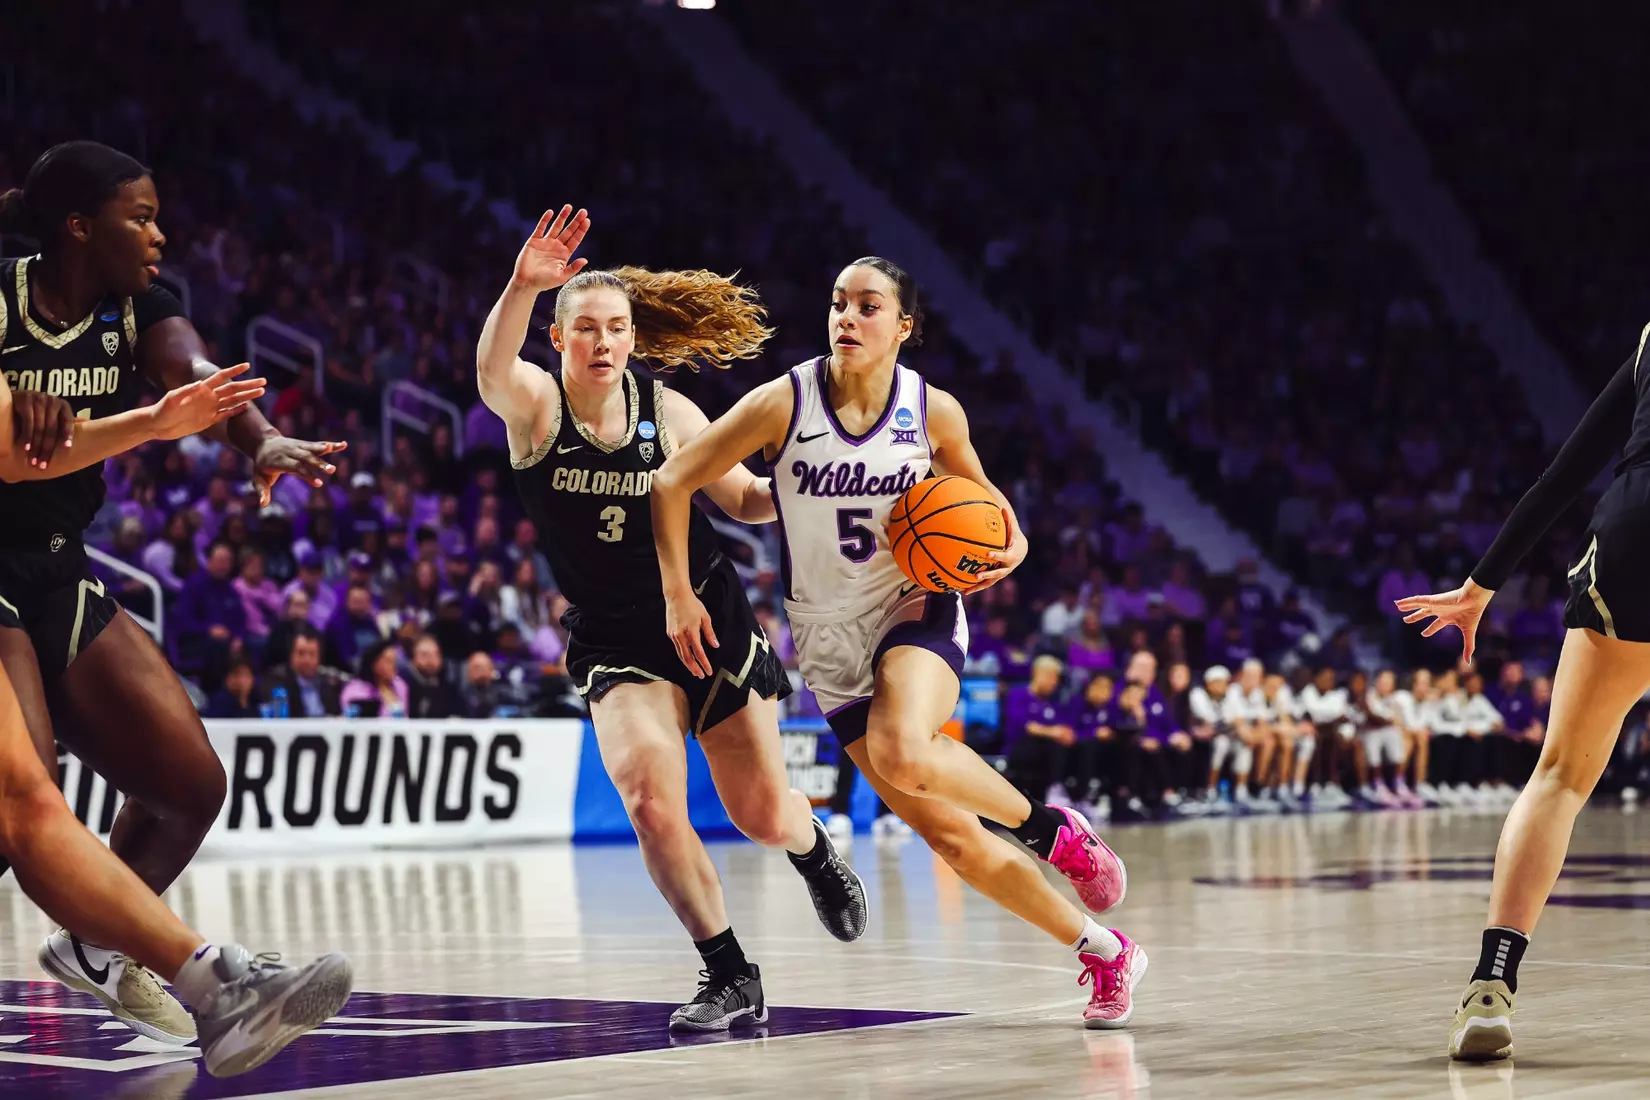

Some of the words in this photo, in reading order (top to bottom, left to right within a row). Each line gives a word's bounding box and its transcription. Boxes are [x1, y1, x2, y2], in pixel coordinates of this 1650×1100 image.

[791, 460, 917, 497] Wildcats
[597, 506, 626, 542] 3
[836, 508, 877, 563] 5
[227, 733, 522, 831] ROUNDS
